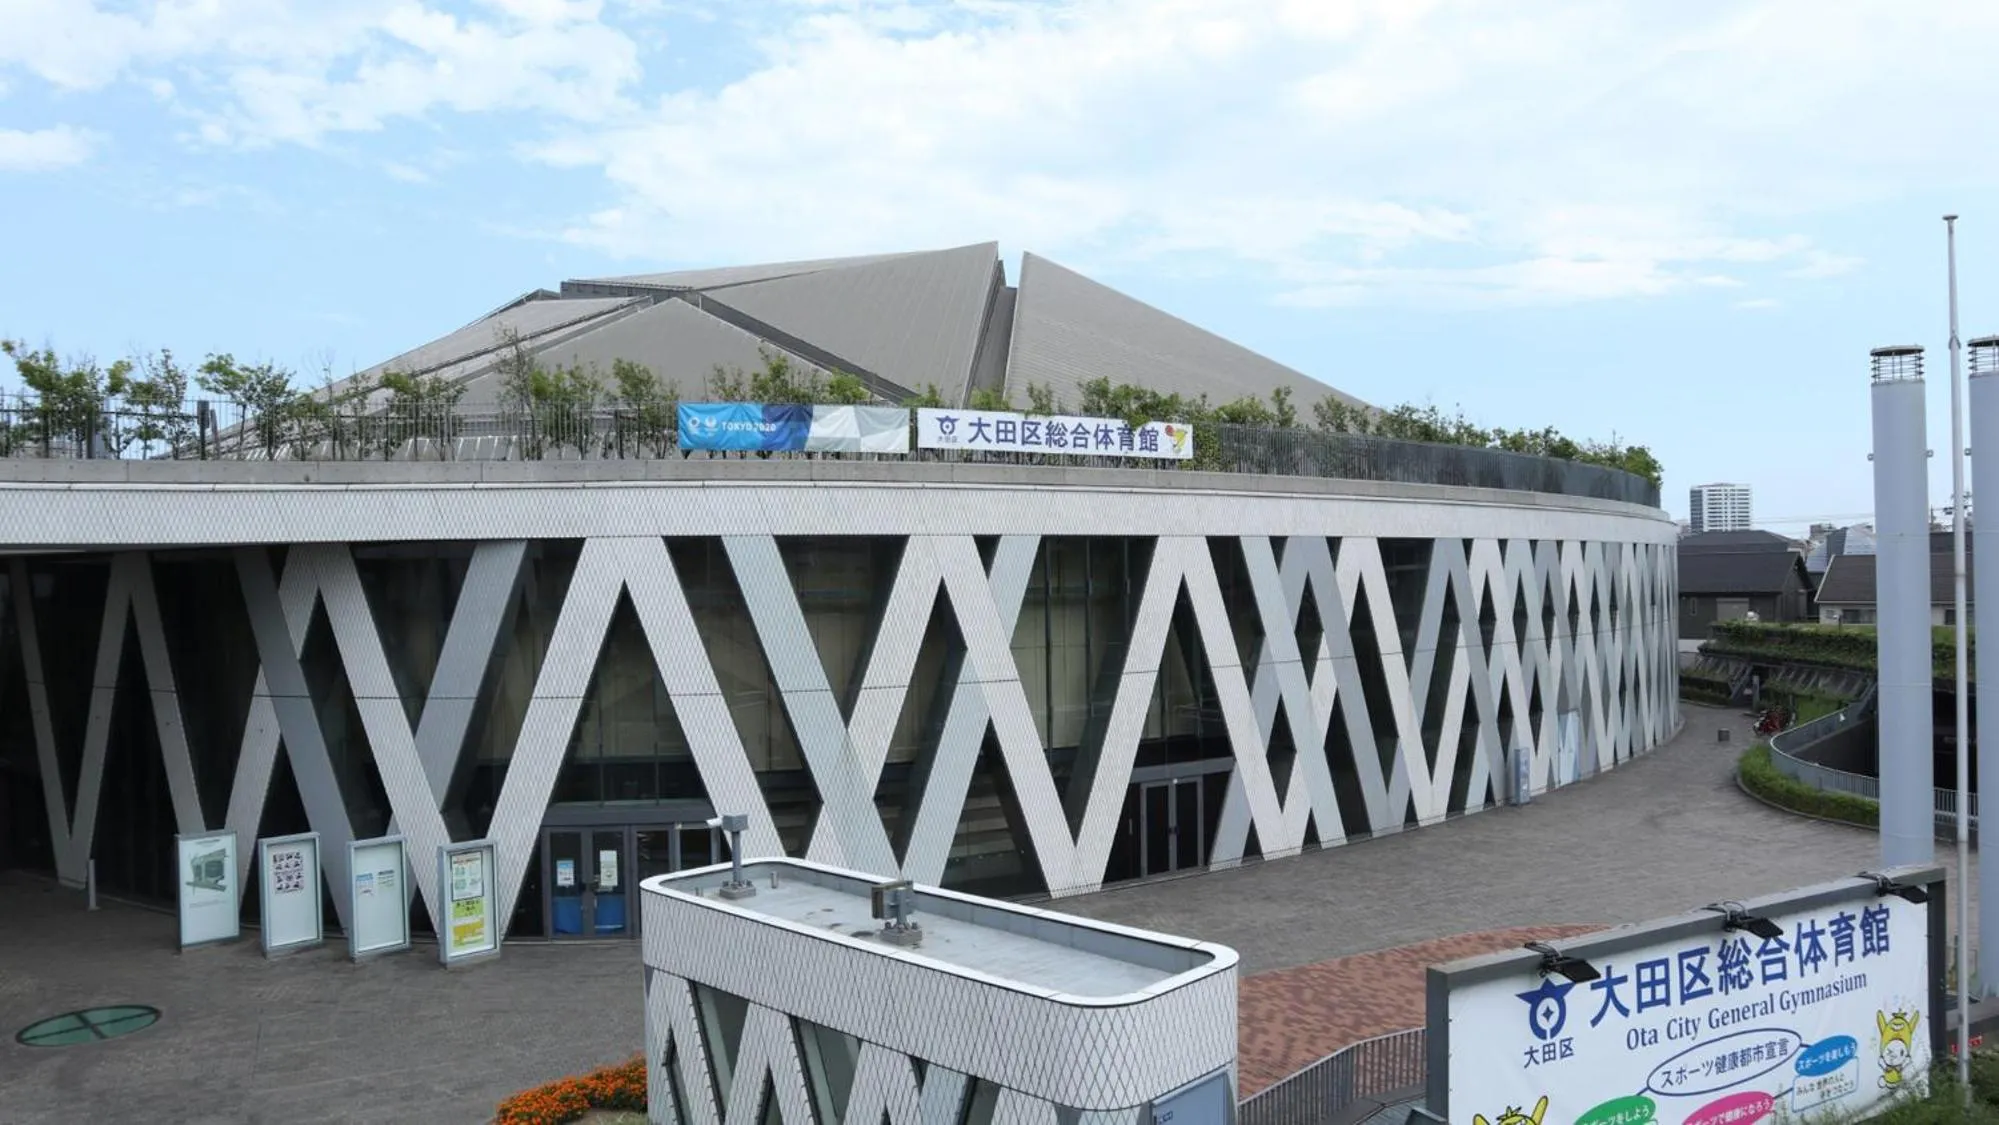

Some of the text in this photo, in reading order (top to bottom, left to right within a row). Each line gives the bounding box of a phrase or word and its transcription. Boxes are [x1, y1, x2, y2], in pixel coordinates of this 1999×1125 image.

[721, 421, 752, 432] TOKYO
[752, 422, 777, 433] 2020
[967, 416, 1160, 453] 大田区総合体育館
[1589, 903, 1891, 1029] 大田区総合体育館
[1626, 972, 1868, 1052] Ota City General Gymnasium
[1523, 1036, 1575, 1069] 大田区
[1660, 1037, 1790, 1089] スポーツ健康都市宣言
